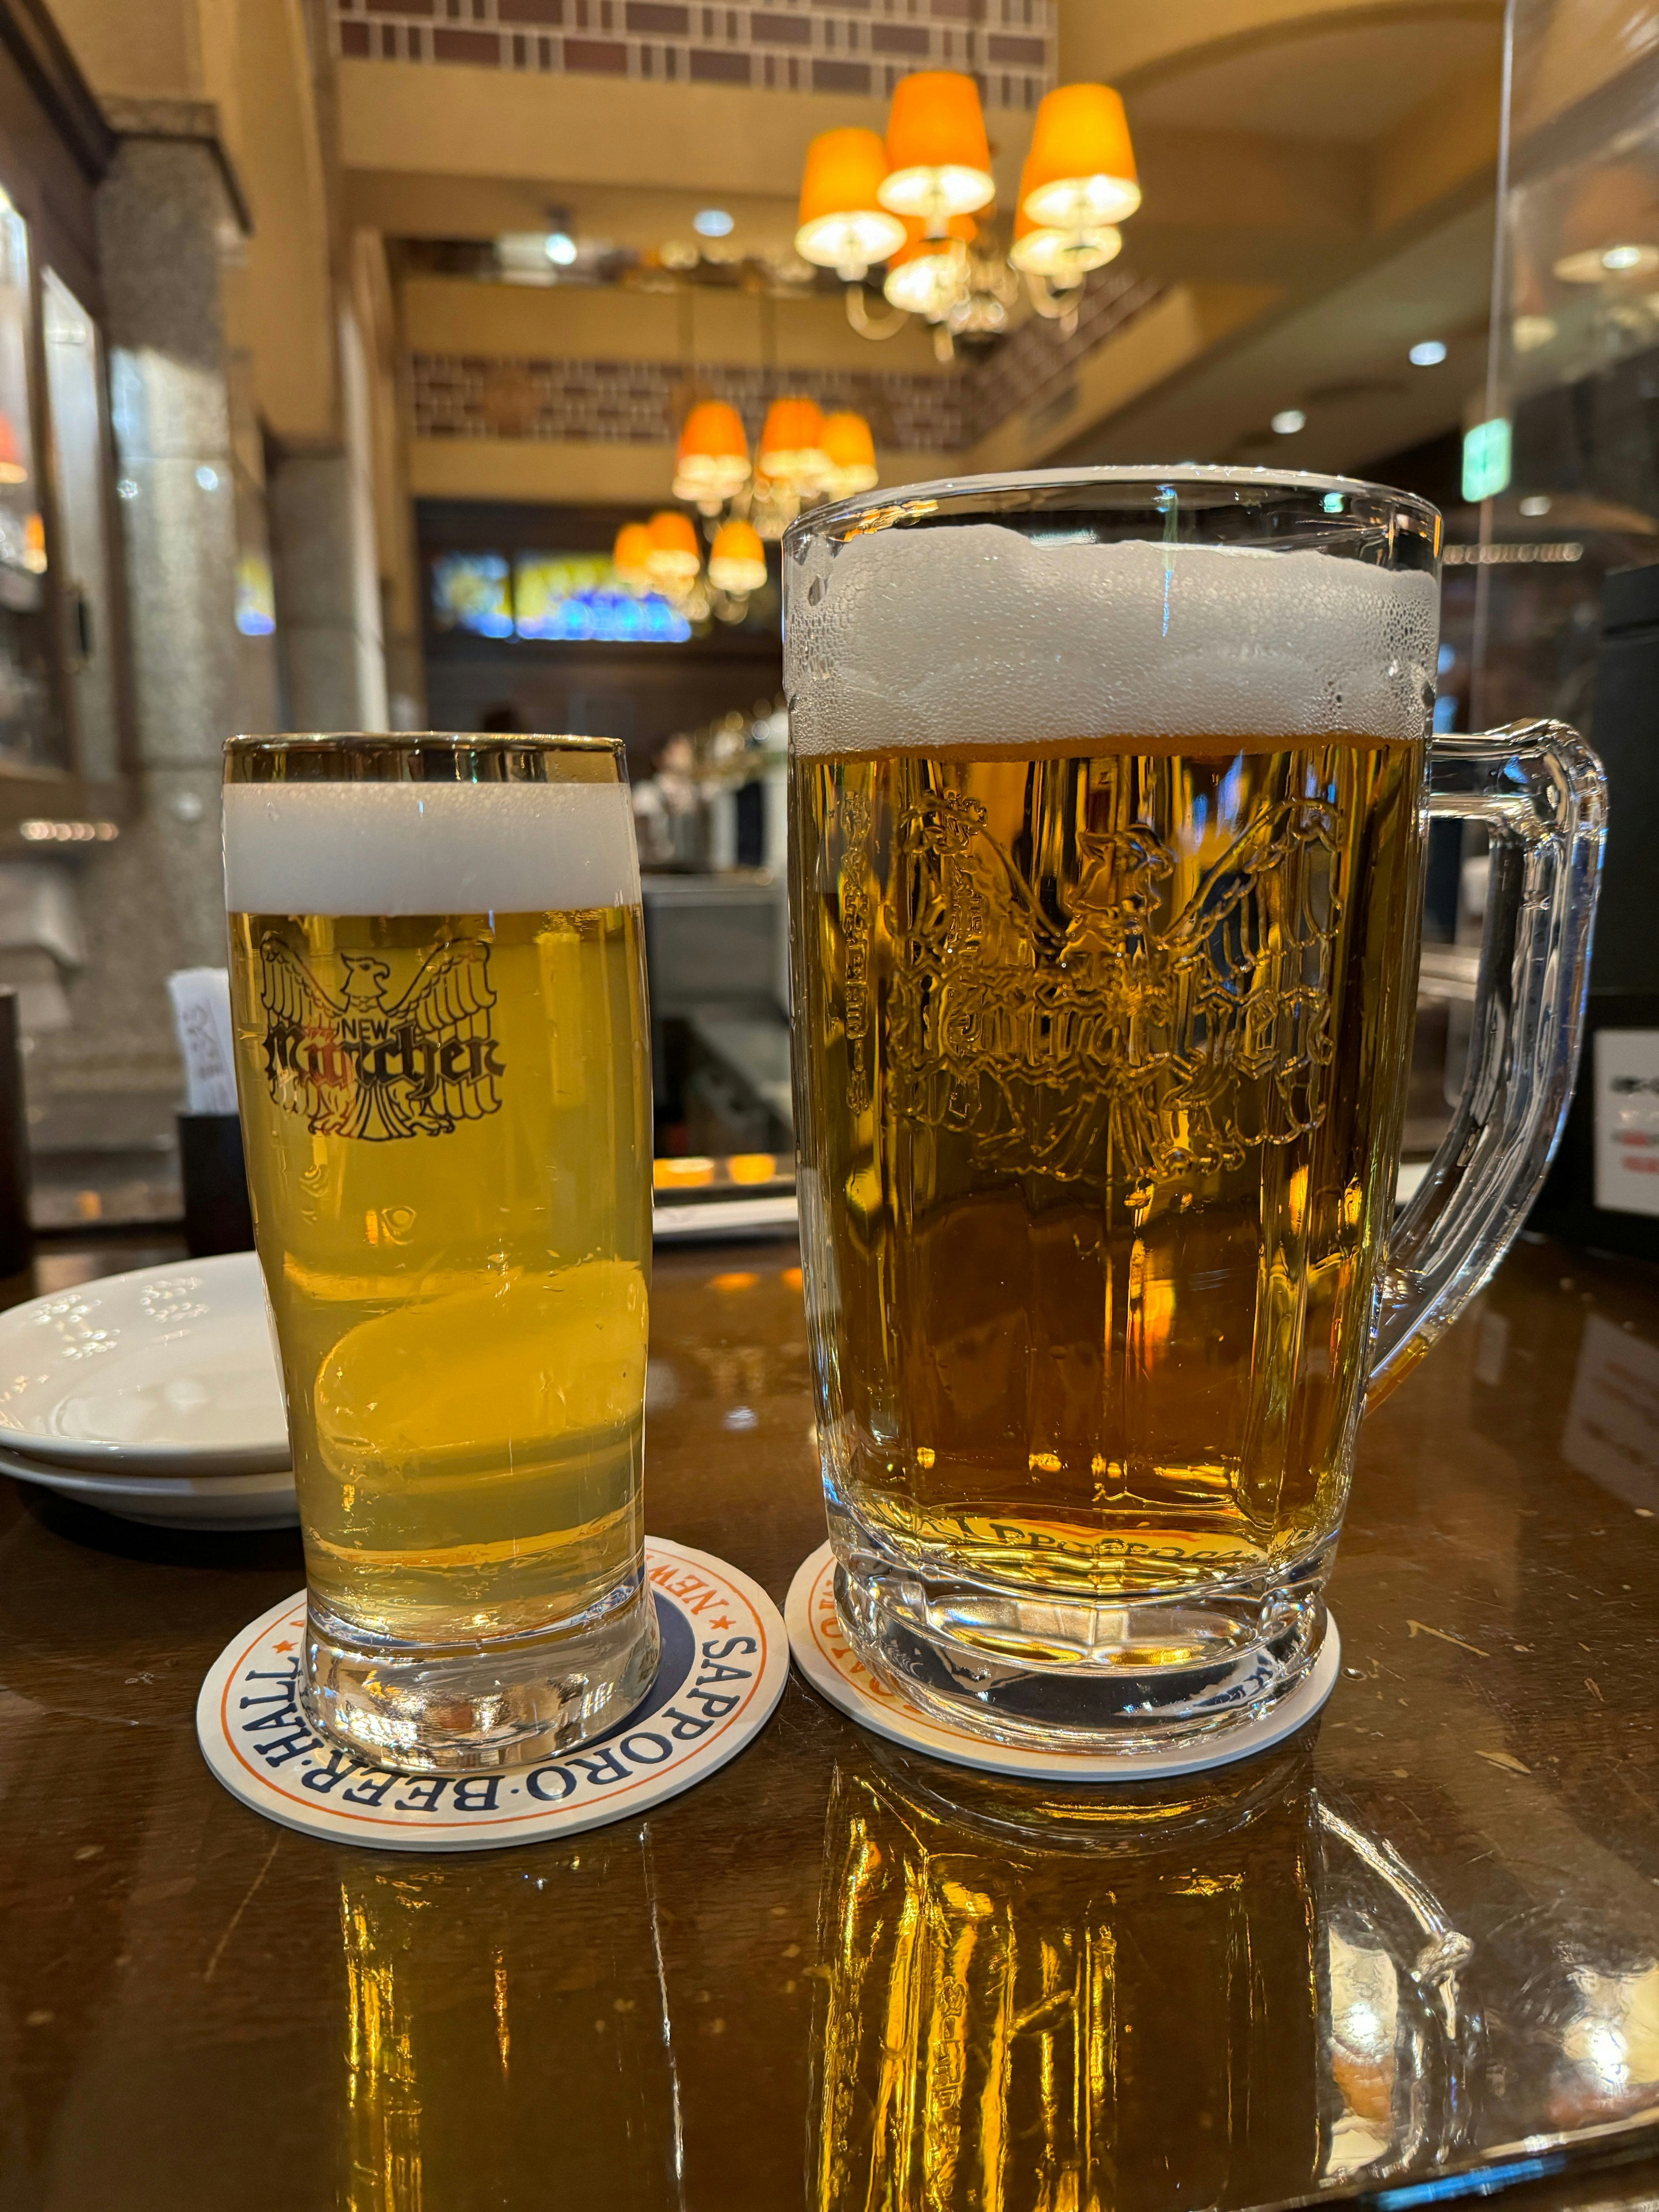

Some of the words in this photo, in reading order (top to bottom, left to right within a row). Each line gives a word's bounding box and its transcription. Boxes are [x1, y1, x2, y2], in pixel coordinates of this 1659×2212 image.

[342, 1018, 389, 1040] NEW
[648, 1564, 730, 1616] NEW
[239, 1656, 324, 1768] HALL
[526, 1636, 758, 1801] SAPPORO
[301, 1749, 505, 1812] BEER
